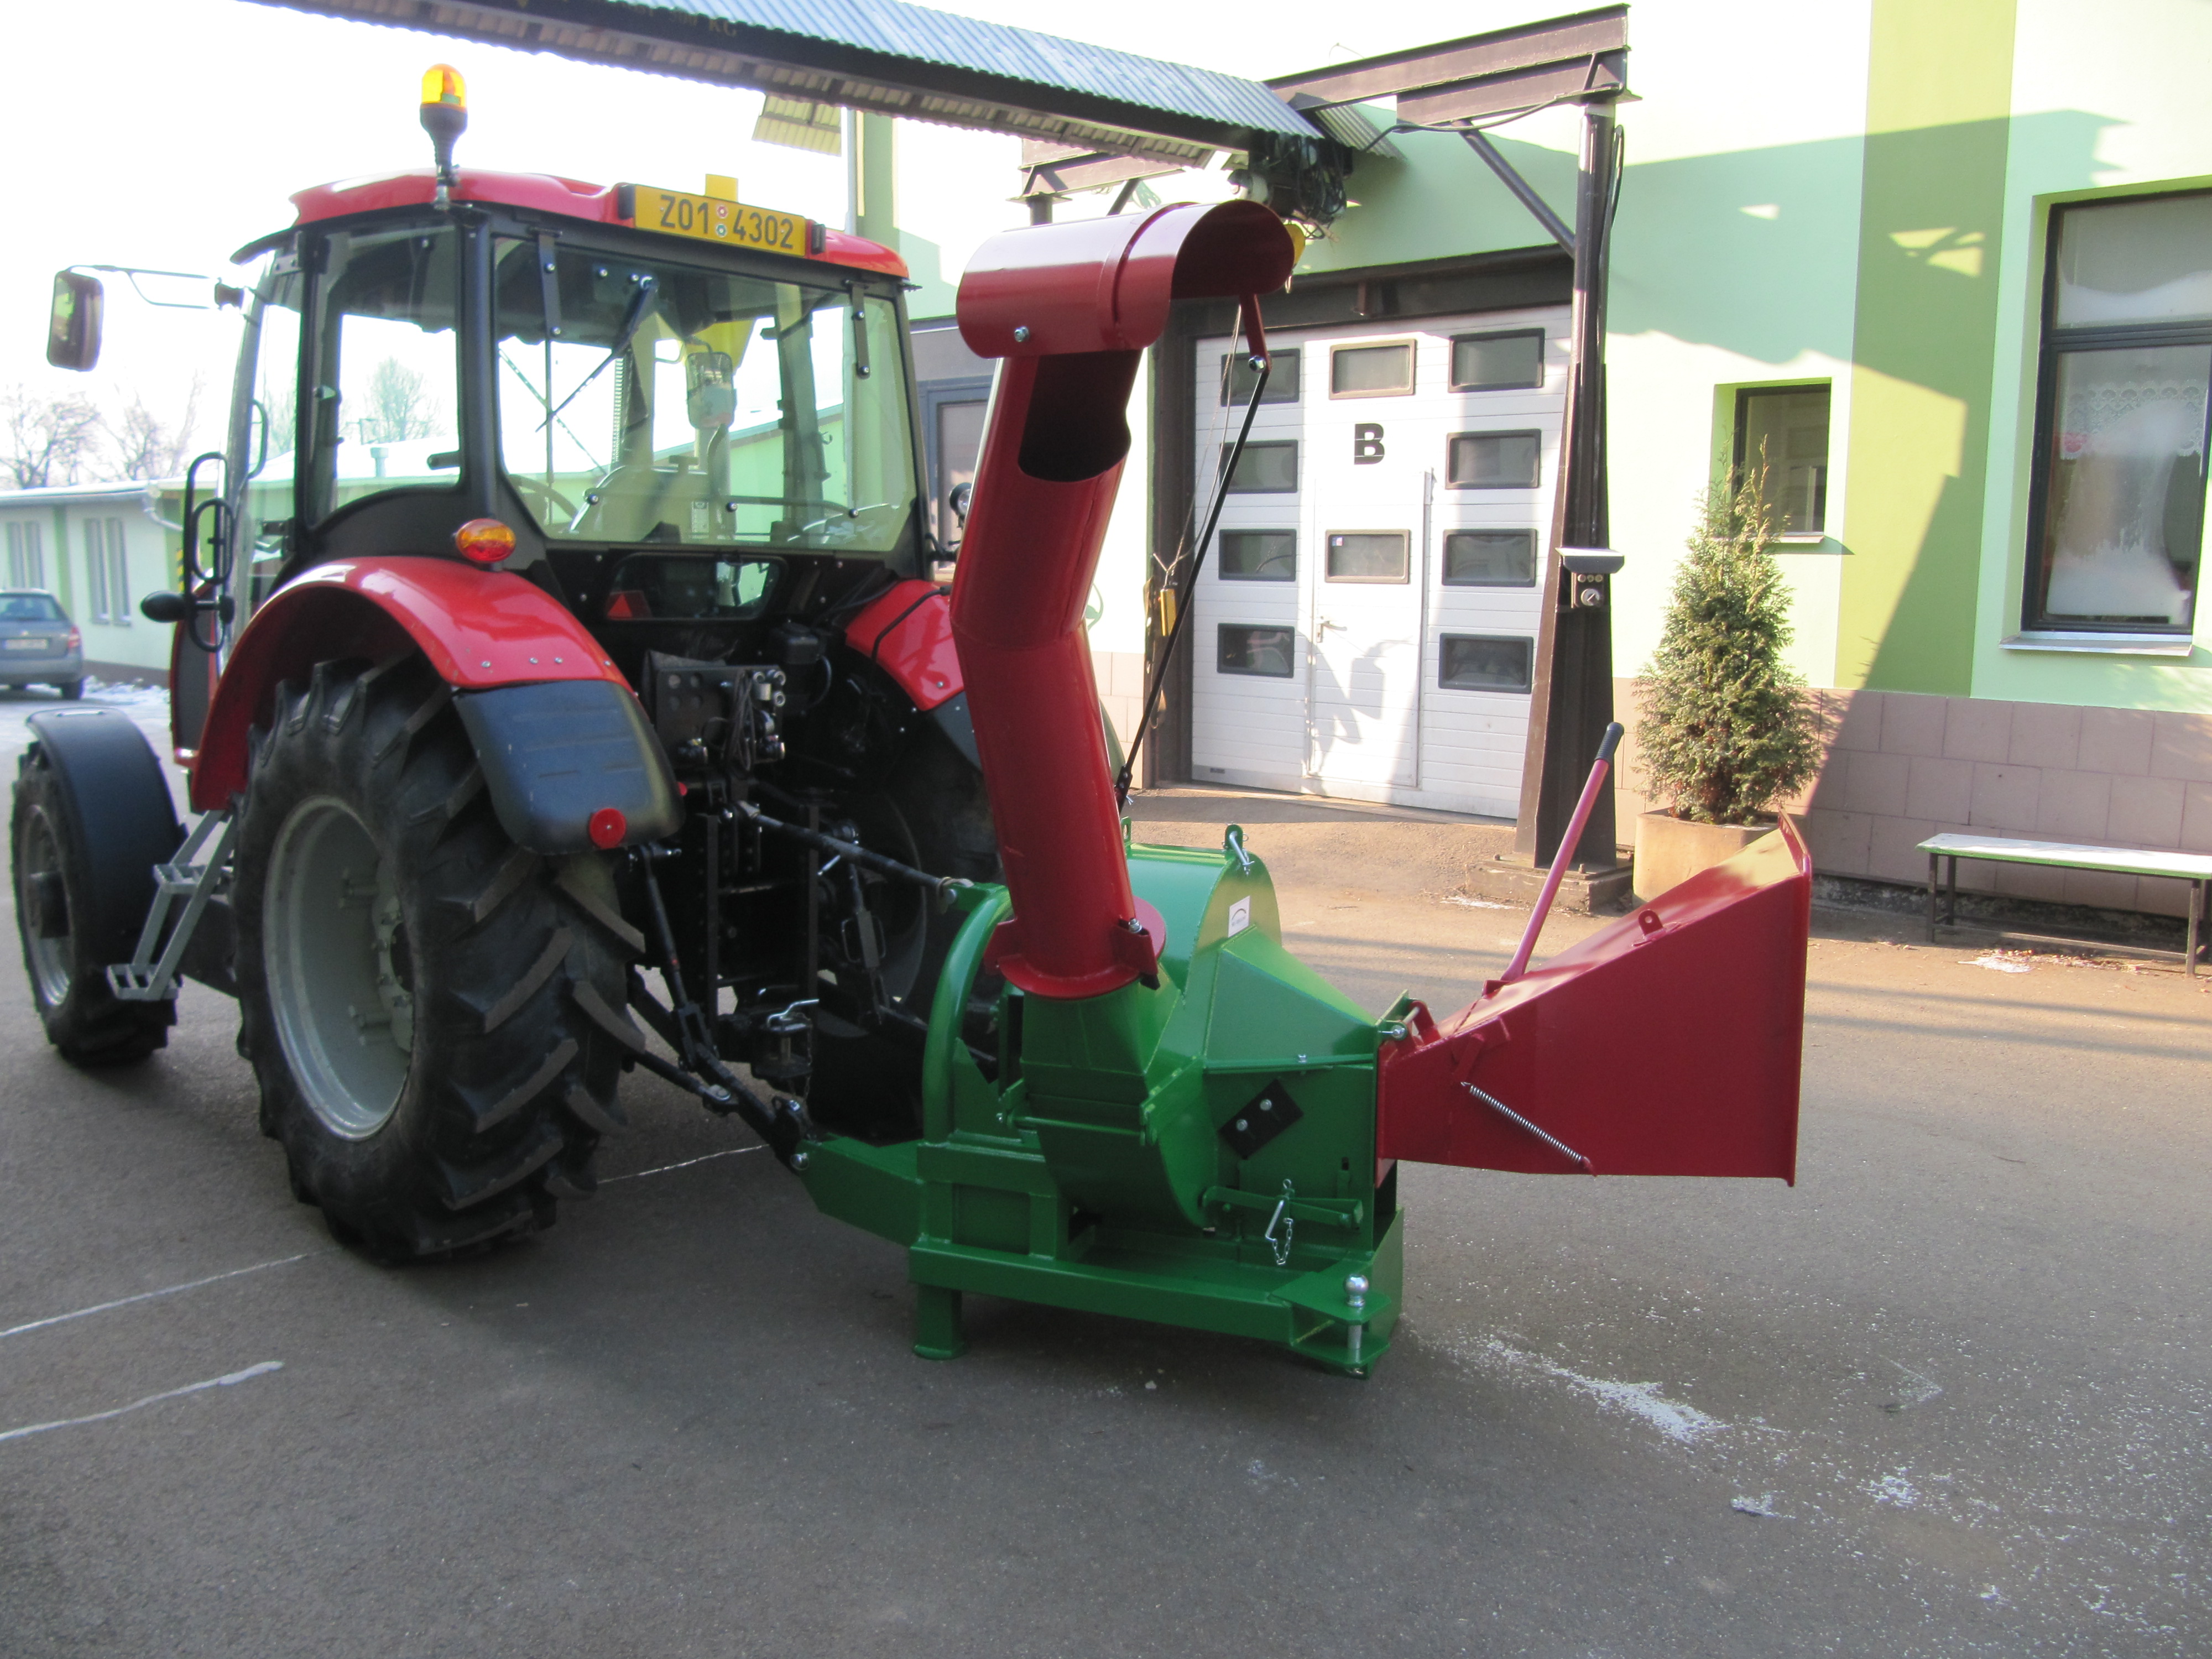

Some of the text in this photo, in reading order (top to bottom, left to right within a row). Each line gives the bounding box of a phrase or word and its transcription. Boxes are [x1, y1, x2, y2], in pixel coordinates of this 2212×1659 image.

[660, 194, 794, 249] Z01 4302
[1354, 423, 1385, 465] B
